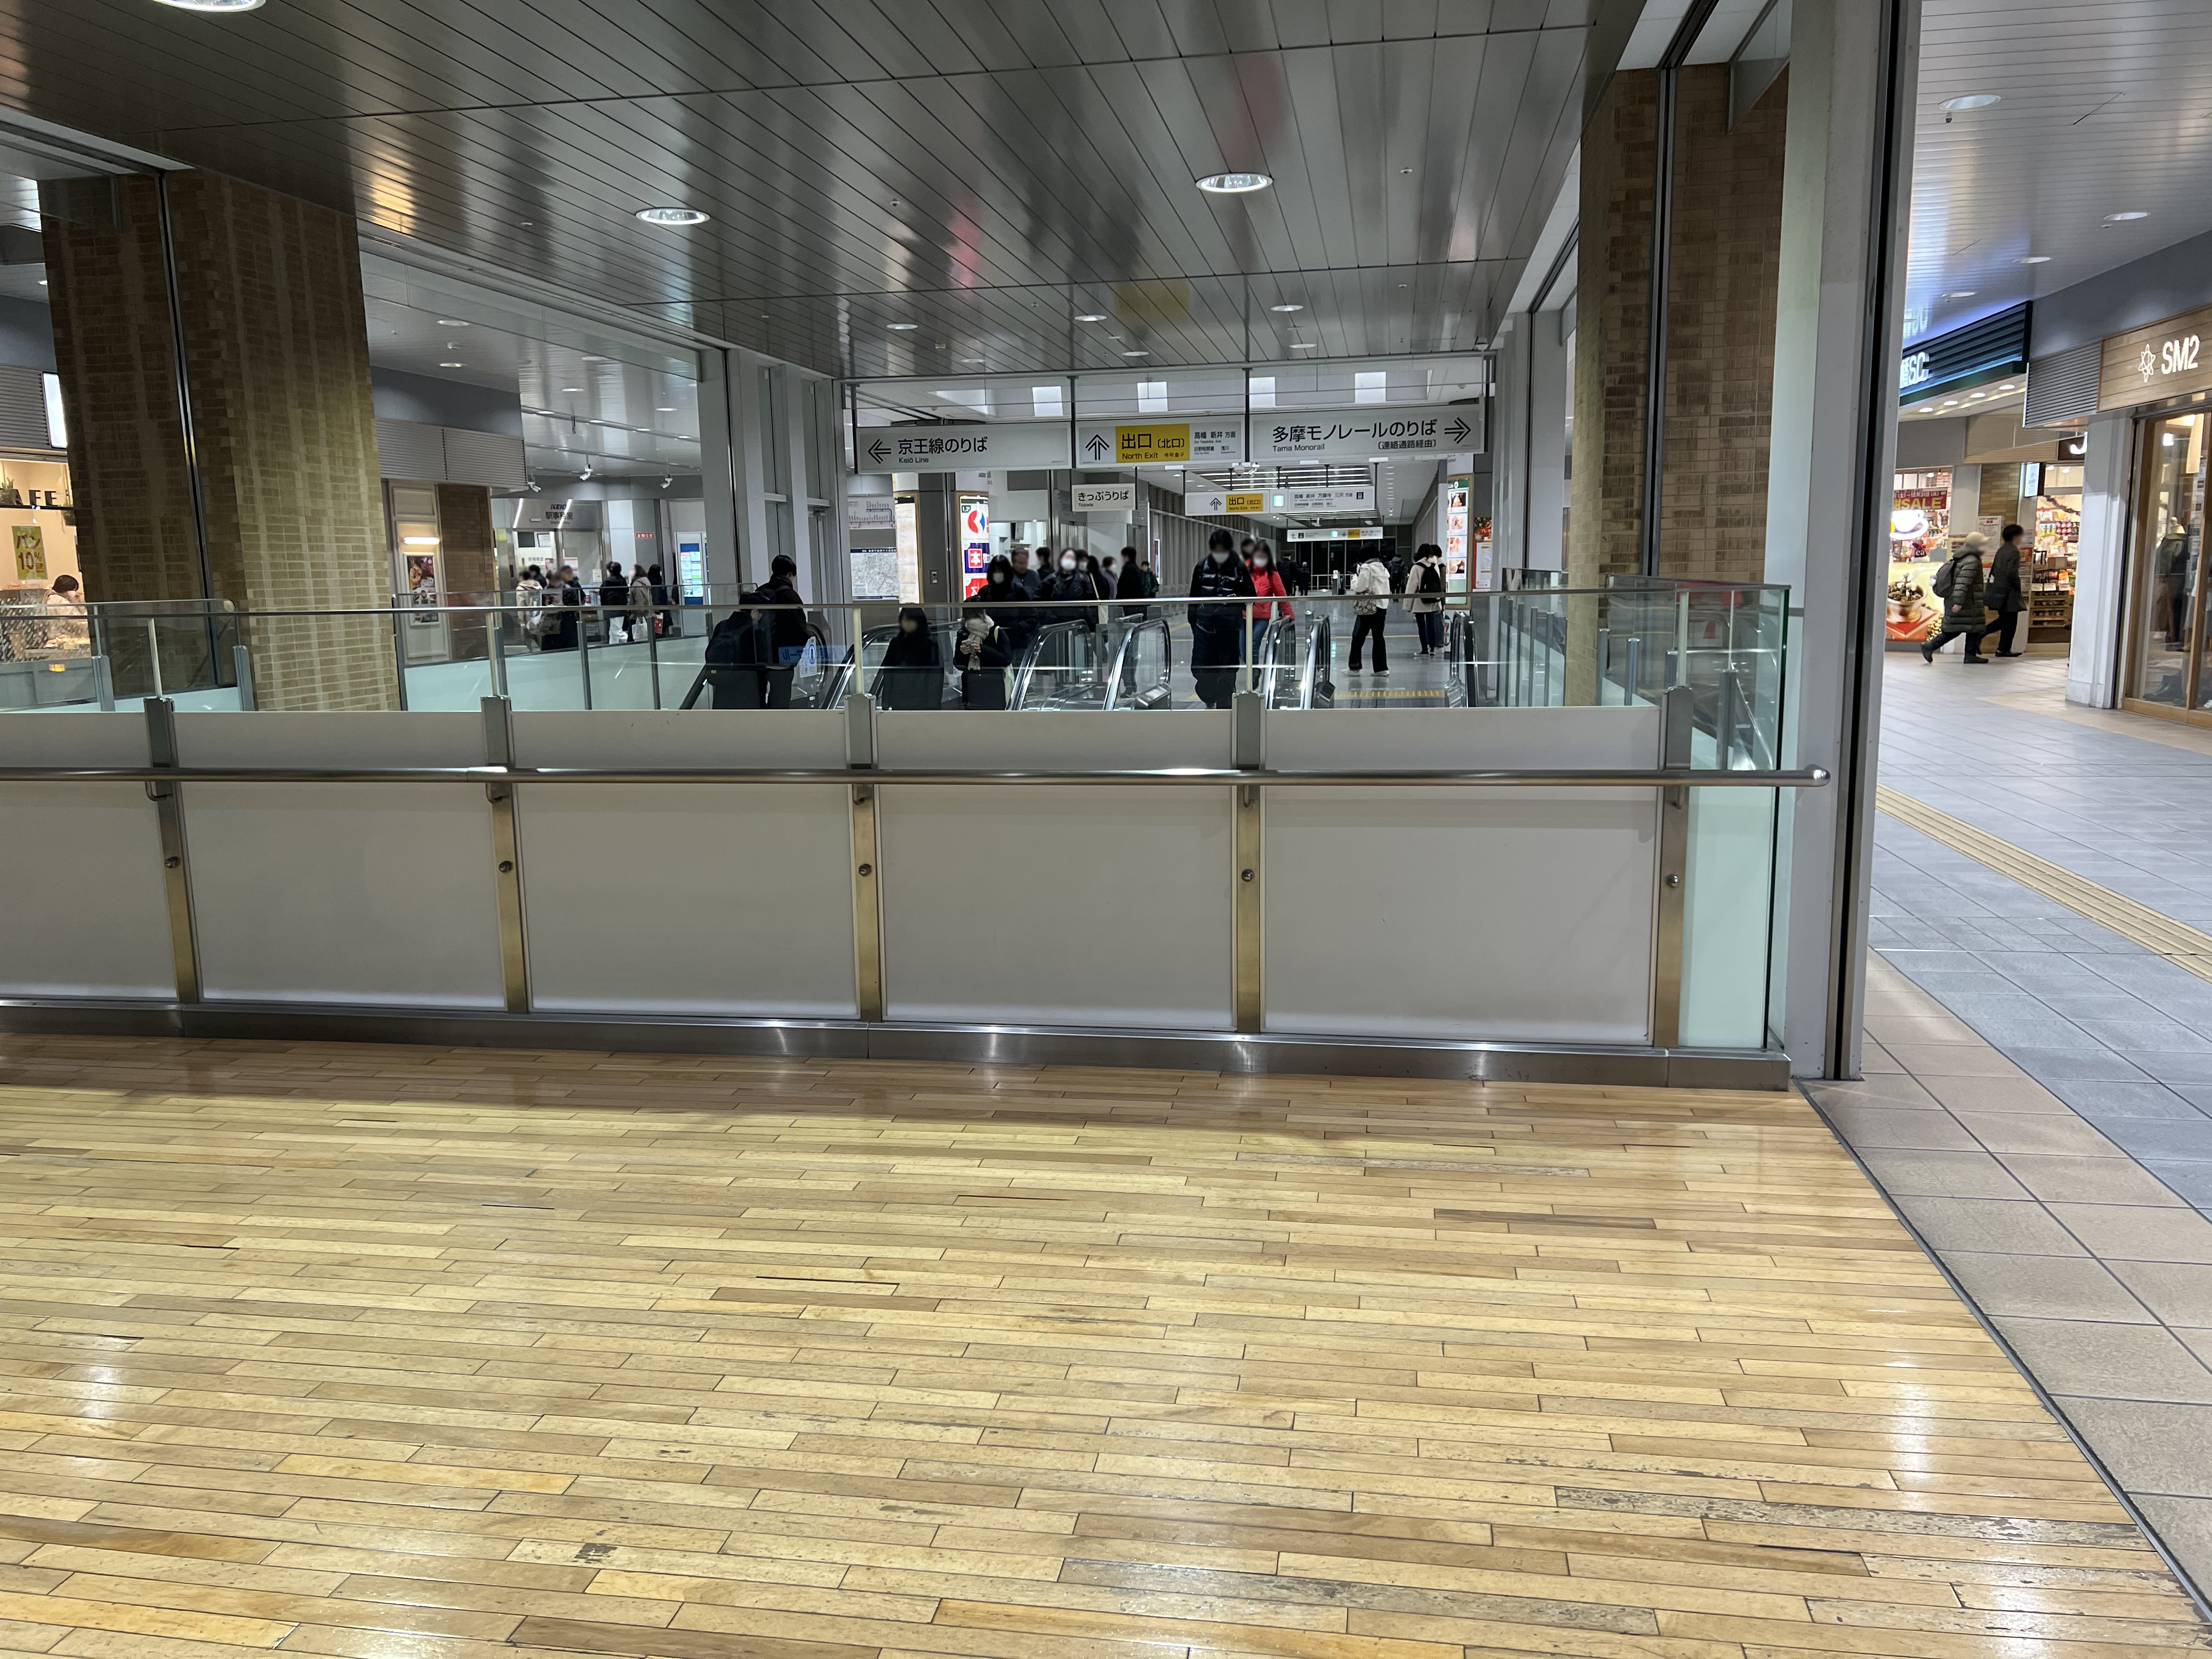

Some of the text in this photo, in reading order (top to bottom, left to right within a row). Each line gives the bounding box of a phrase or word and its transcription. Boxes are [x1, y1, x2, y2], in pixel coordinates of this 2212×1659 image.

[2161, 335, 2200, 375] SM2
[1272, 419, 1437, 443] 多摩モノレールのりば
[898, 436, 988, 454] 京王線のりば
[1122, 433, 1152, 449] 出口
[1077, 490, 1130, 501] きっぷうりば
[970, 551, 981, 565] 本
